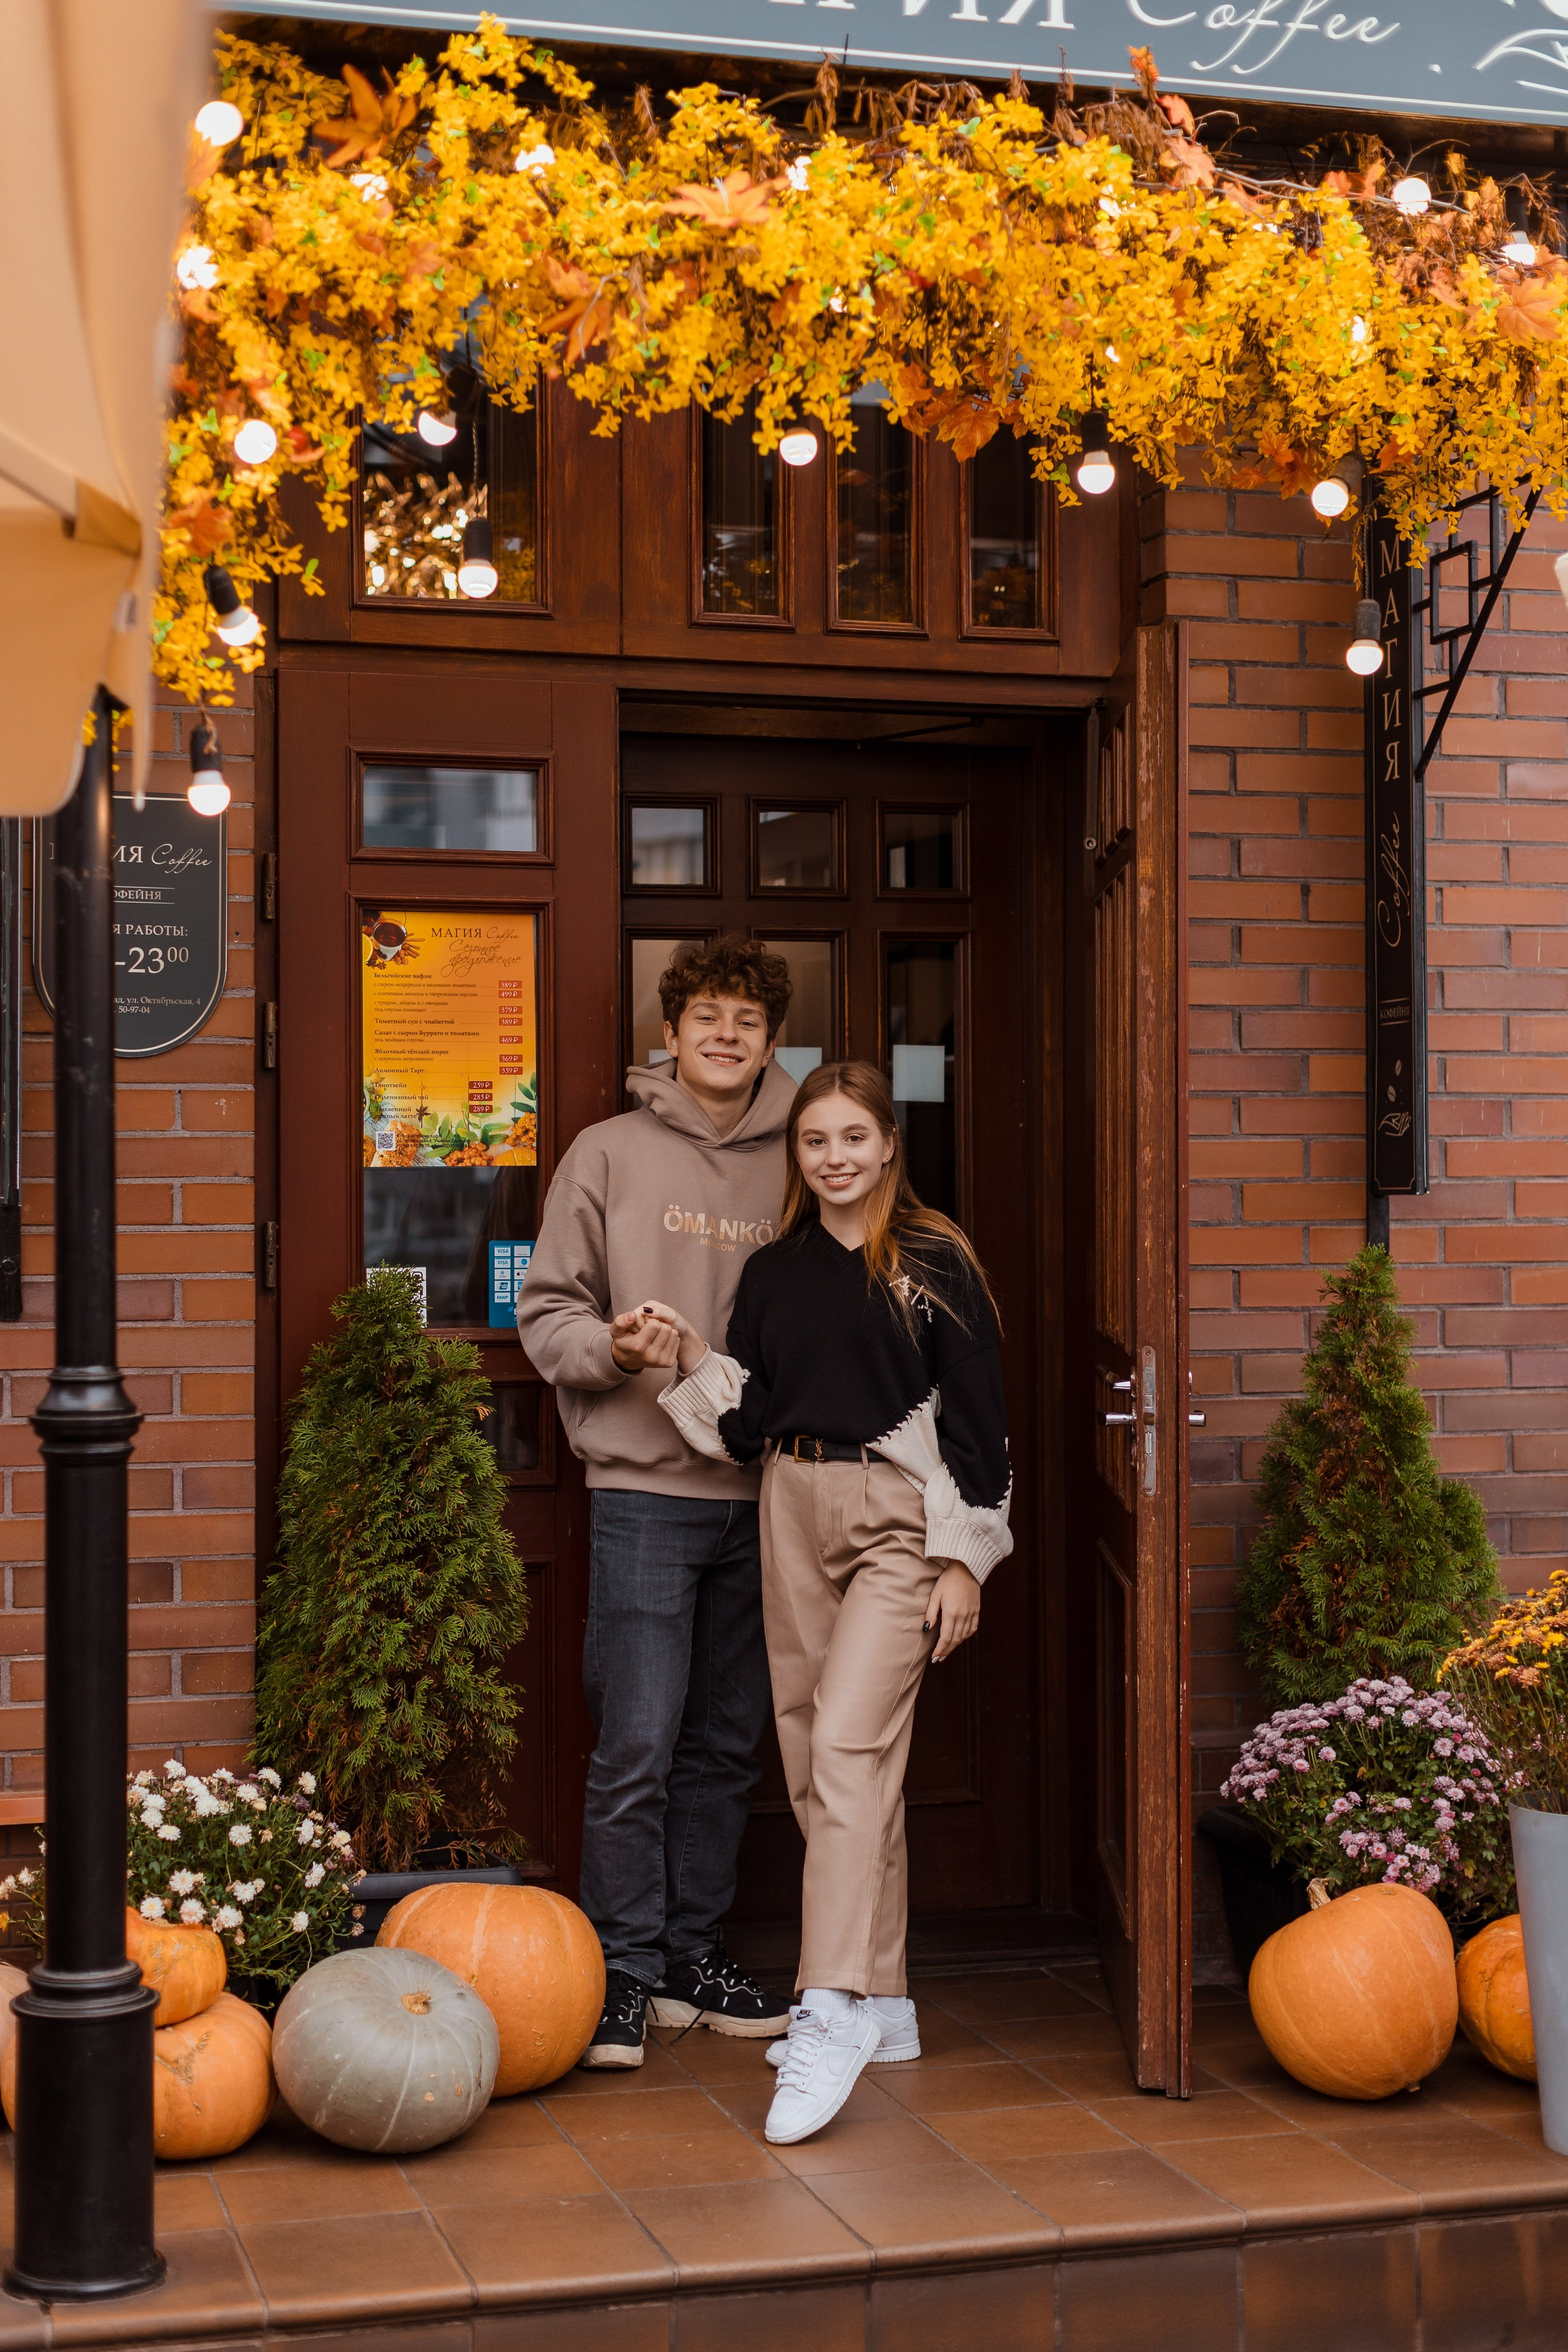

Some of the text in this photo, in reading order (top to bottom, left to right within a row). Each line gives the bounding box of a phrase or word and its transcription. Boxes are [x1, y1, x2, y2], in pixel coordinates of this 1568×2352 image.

[1130, 0, 1400, 74] offee
[1379, 533, 1401, 782] МАГИЯ
[152, 843, 213, 874] Coffee
[1378, 811, 1409, 947] Coffee
[126, 924, 188, 937] РАБОТЫ:
[431, 928, 482, 938] МАГИЯ
[127, 997, 139, 1006] ул.
[140, 996, 195, 1006] Октябрьская,
[1379, 1006, 1410, 1019] КОФЕЙНЯ
[663, 1204, 774, 1246] ÖMANKÖ
[699, 1237, 737, 1252] MOSCOW
